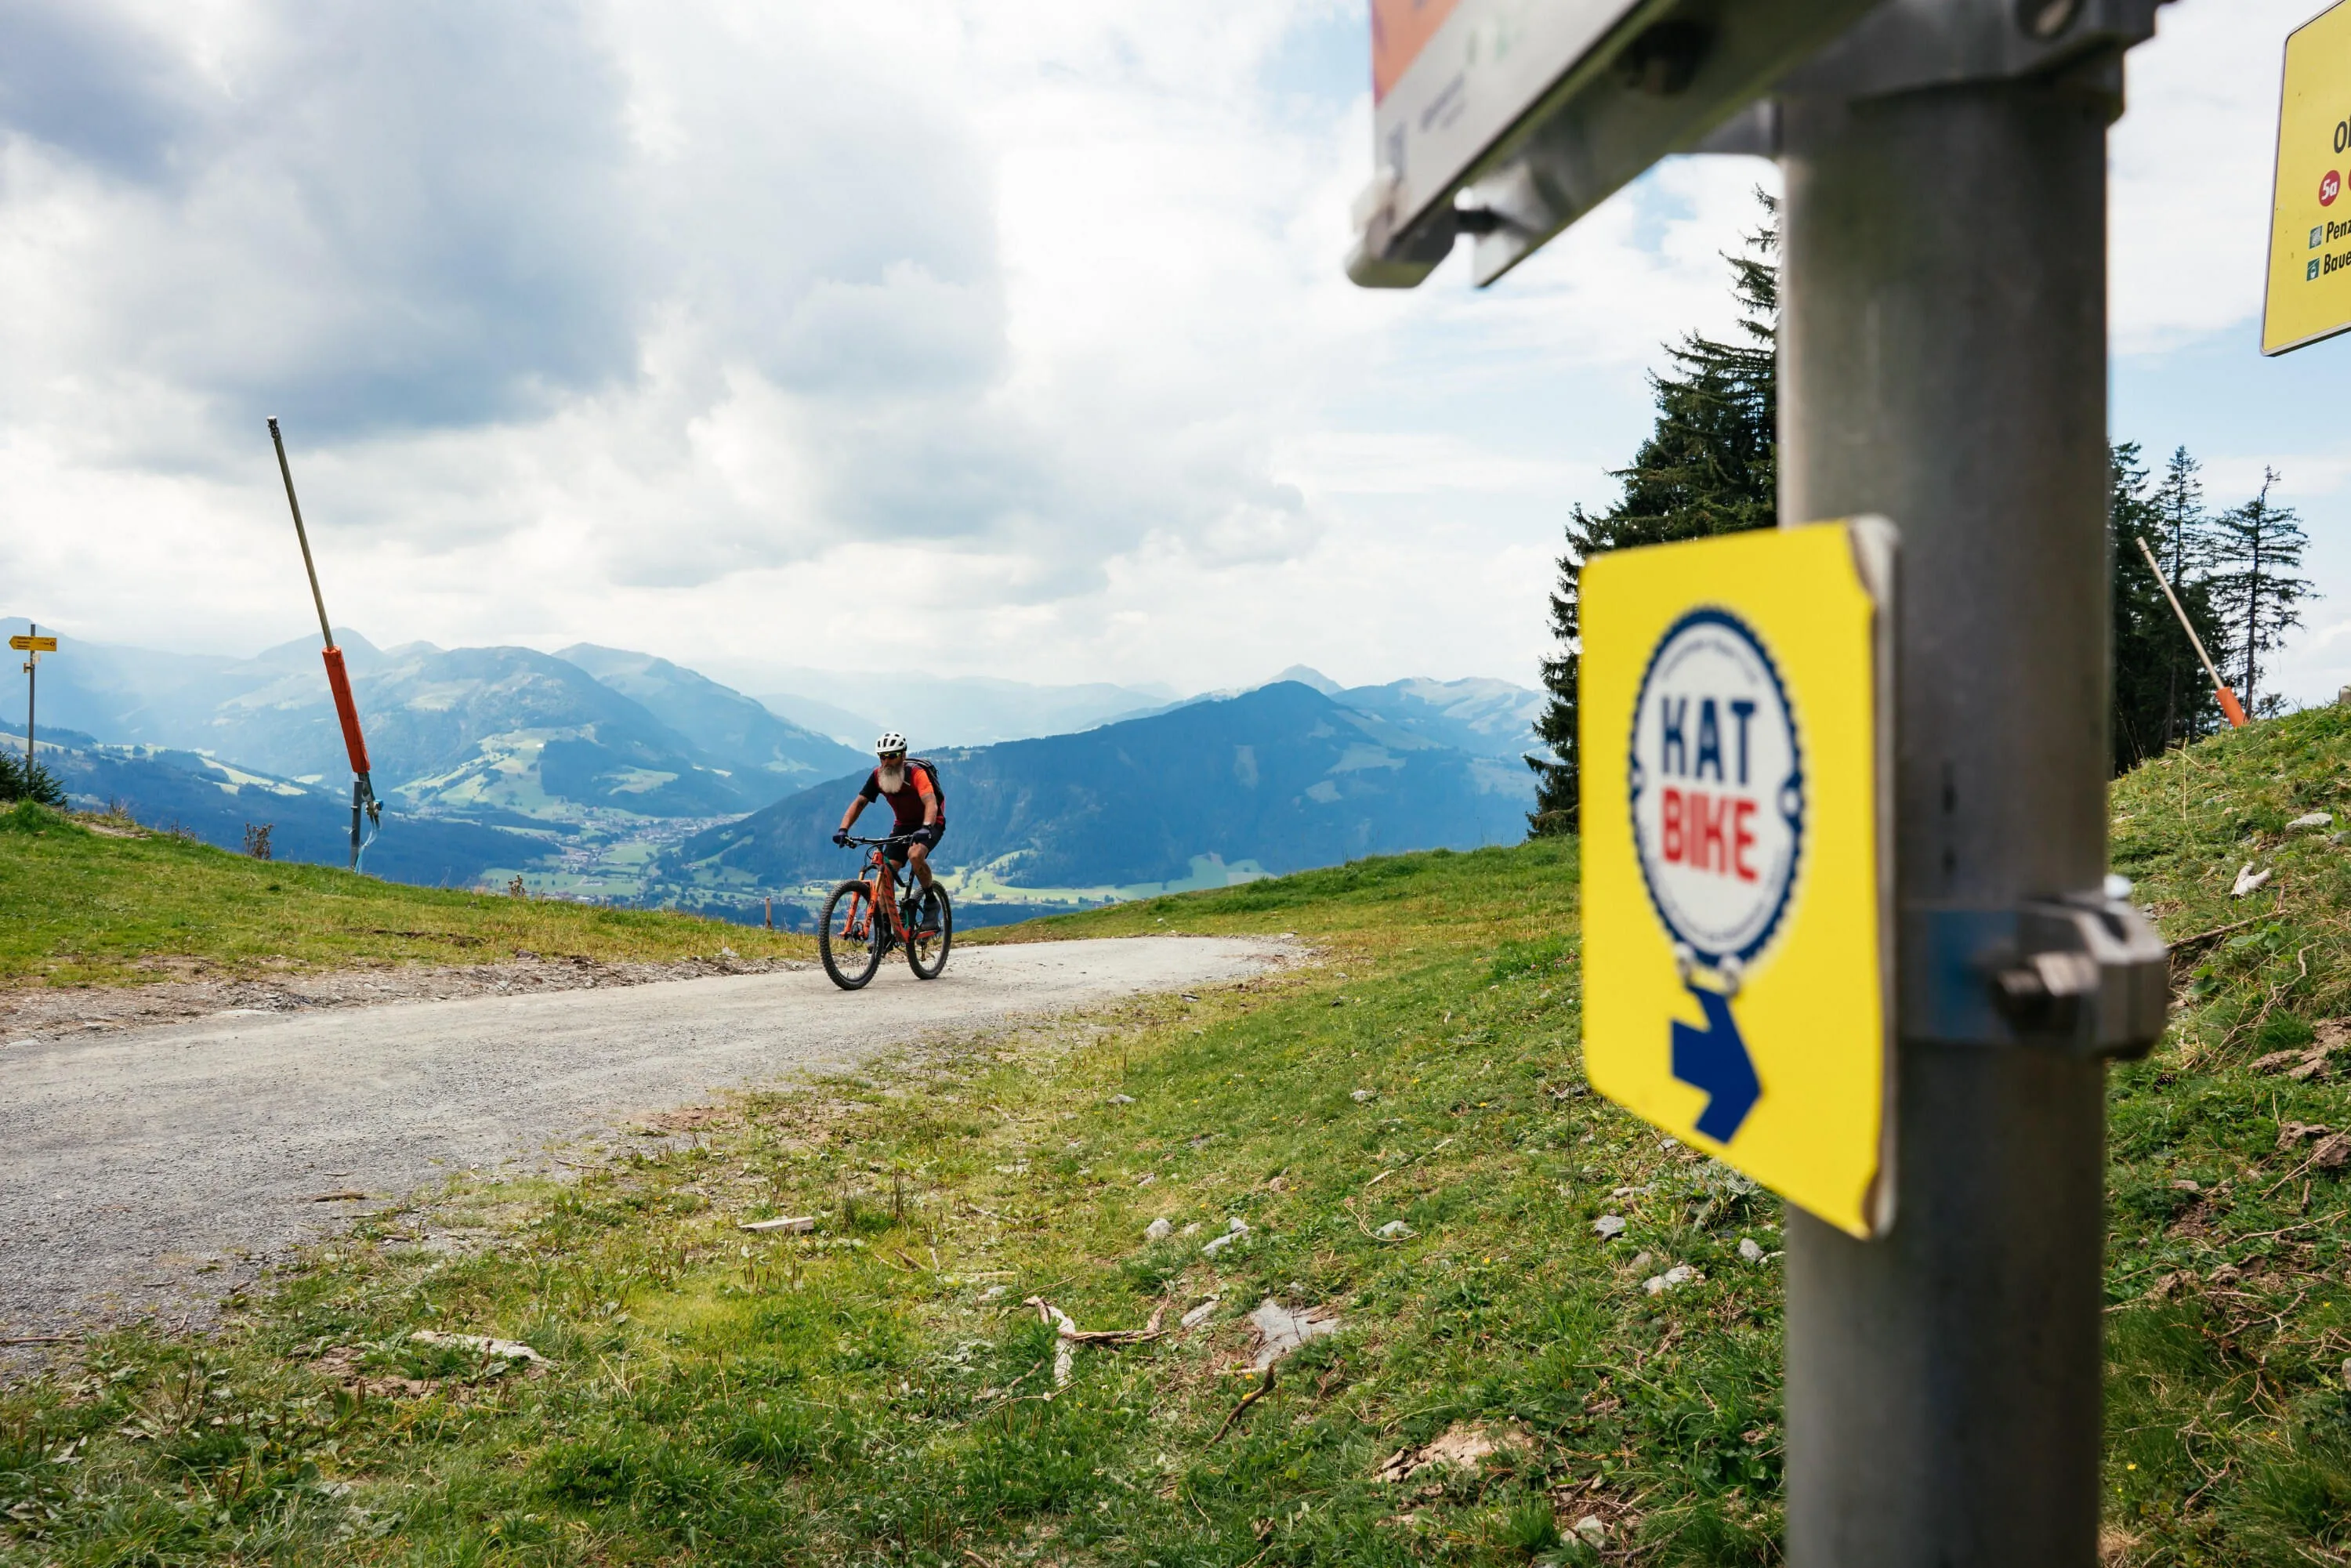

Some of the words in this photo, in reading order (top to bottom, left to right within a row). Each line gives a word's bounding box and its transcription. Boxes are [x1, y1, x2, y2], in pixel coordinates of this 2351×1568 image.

[2334, 114, 2351, 154] O
[2321, 179, 2338, 201] 5a
[2324, 251, 2351, 275] Baue
[1661, 695, 1758, 786] KAT
[1662, 786, 1759, 884] BIKE
